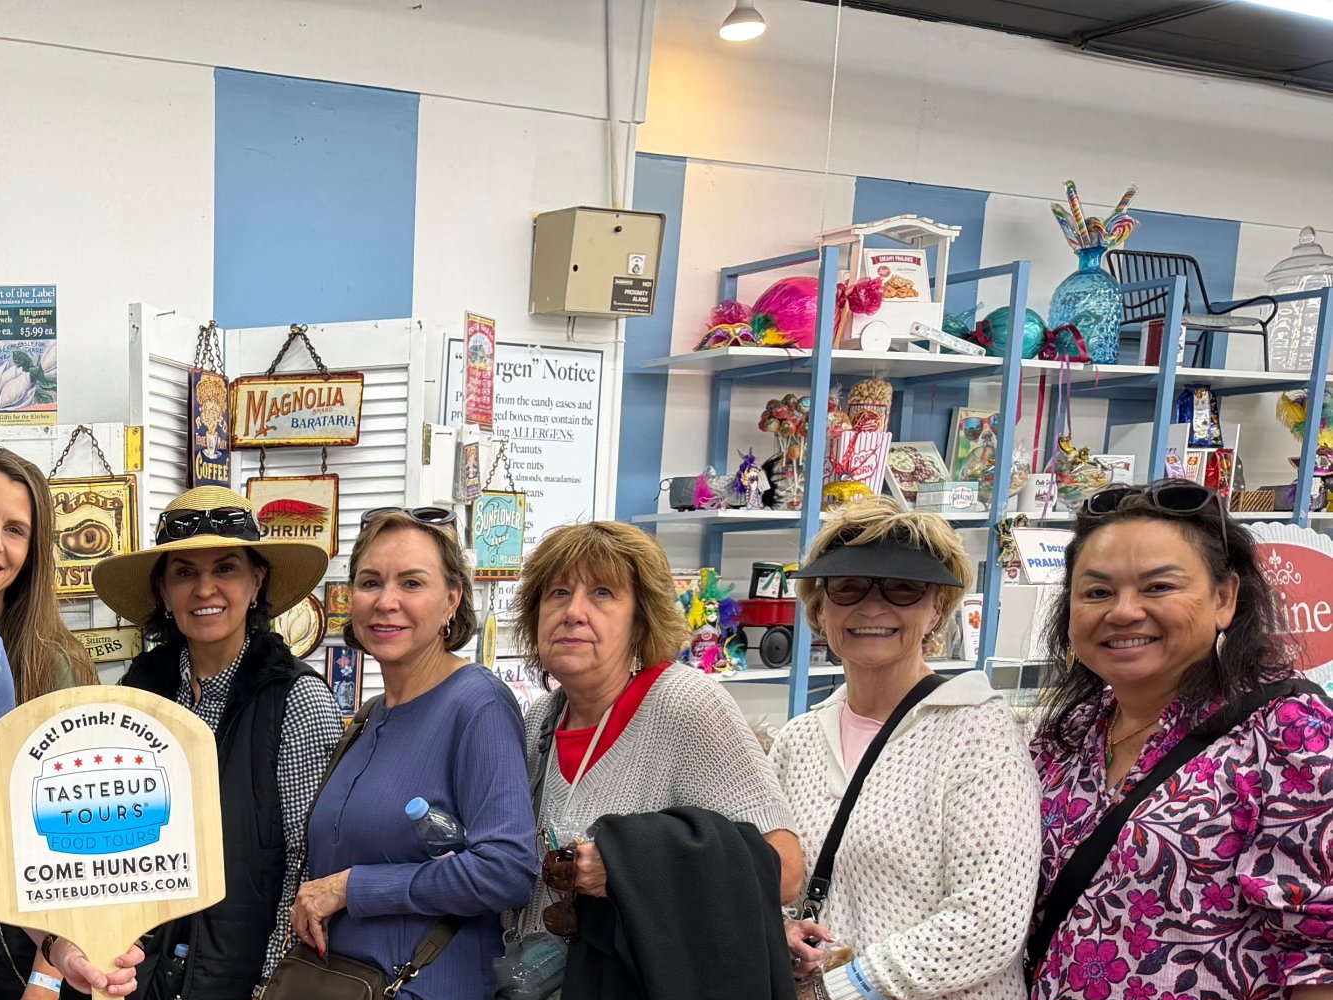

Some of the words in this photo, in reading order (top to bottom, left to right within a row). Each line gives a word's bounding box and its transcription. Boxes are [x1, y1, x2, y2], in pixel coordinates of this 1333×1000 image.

[6, 288, 15, 298] of
[16, 288, 30, 298] the
[32, 288, 55, 298] Label
[19, 309, 53, 317] Refrigerator
[24, 316, 47, 325] Magnets
[20, 326, 43, 337] $5.99
[543, 358, 596, 382] Notice
[496, 394, 515, 406] from
[517, 395, 529, 406] the
[531, 397, 554, 410] candy
[556, 401, 576, 409] cases
[578, 400, 592, 410] and
[244, 386, 345, 438] MAGNOLIA
[509, 410, 532, 422] boxes
[534, 415, 549, 426] may
[551, 414, 580, 425] contain
[582, 415, 594, 426] the
[291, 415, 356, 431] BARATARIA
[510, 443, 542, 455] Peanuts
[195, 451, 229, 482] COFFEE
[508, 459, 525, 470] Tree
[526, 460, 544, 470] nuts
[68, 494, 114, 509] TASTE
[474, 501, 521, 536] SUNFLOWER
[28, 727, 60, 761] Eat!
[61, 711, 116, 734] Drink!
[120, 714, 169, 754] Enjoy!
[44, 777, 157, 802] TASTEBUD
[51, 836, 97, 850] FOOD
[103, 828, 157, 848] TOURS
[24, 862, 84, 882] COME
[93, 852, 189, 877] HUNGRY!
[26, 877, 190, 901] TASTEBUDTOURS.COM
